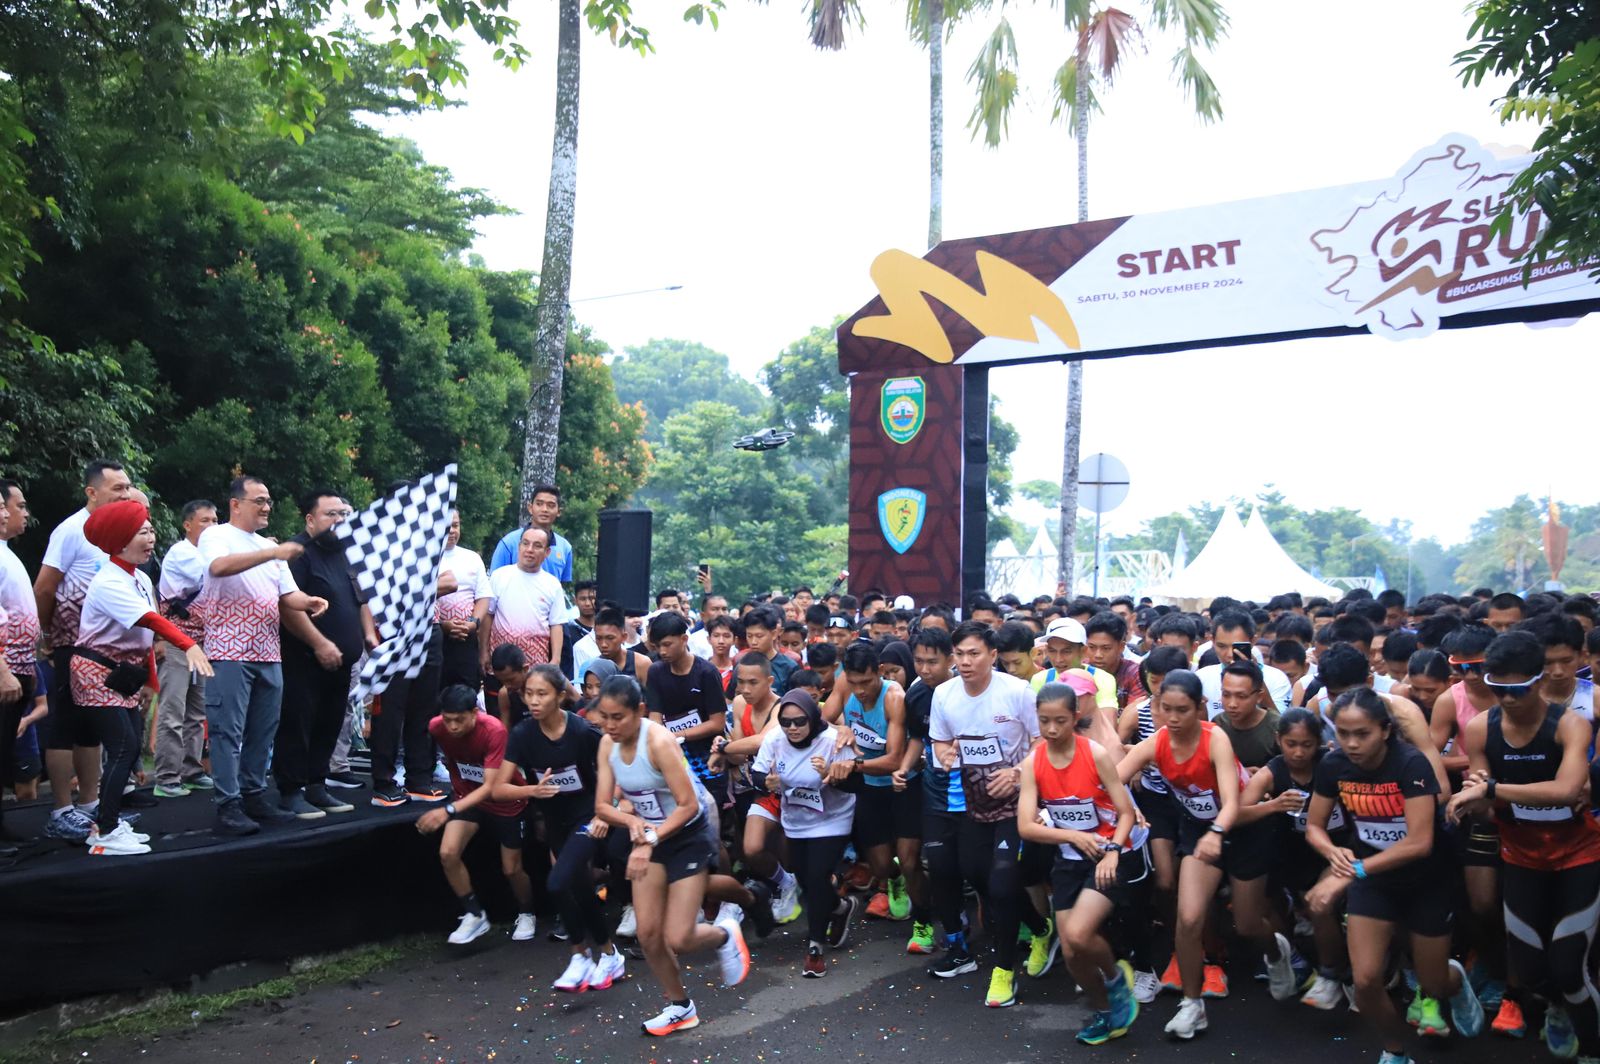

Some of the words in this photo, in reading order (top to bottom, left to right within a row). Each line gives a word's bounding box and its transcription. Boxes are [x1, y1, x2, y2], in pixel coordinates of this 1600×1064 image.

[1116, 239, 1241, 278] START
[1077, 293, 1119, 304] SABTU,
[1122, 290, 1136, 299] 30
[1139, 281, 1210, 296] NOVEMBER
[1213, 278, 1244, 288] 2024
[853, 728, 881, 745] 0409
[963, 744, 996, 756] 06483
[1053, 810, 1092, 822] 16825
[1363, 828, 1407, 842] 16330
